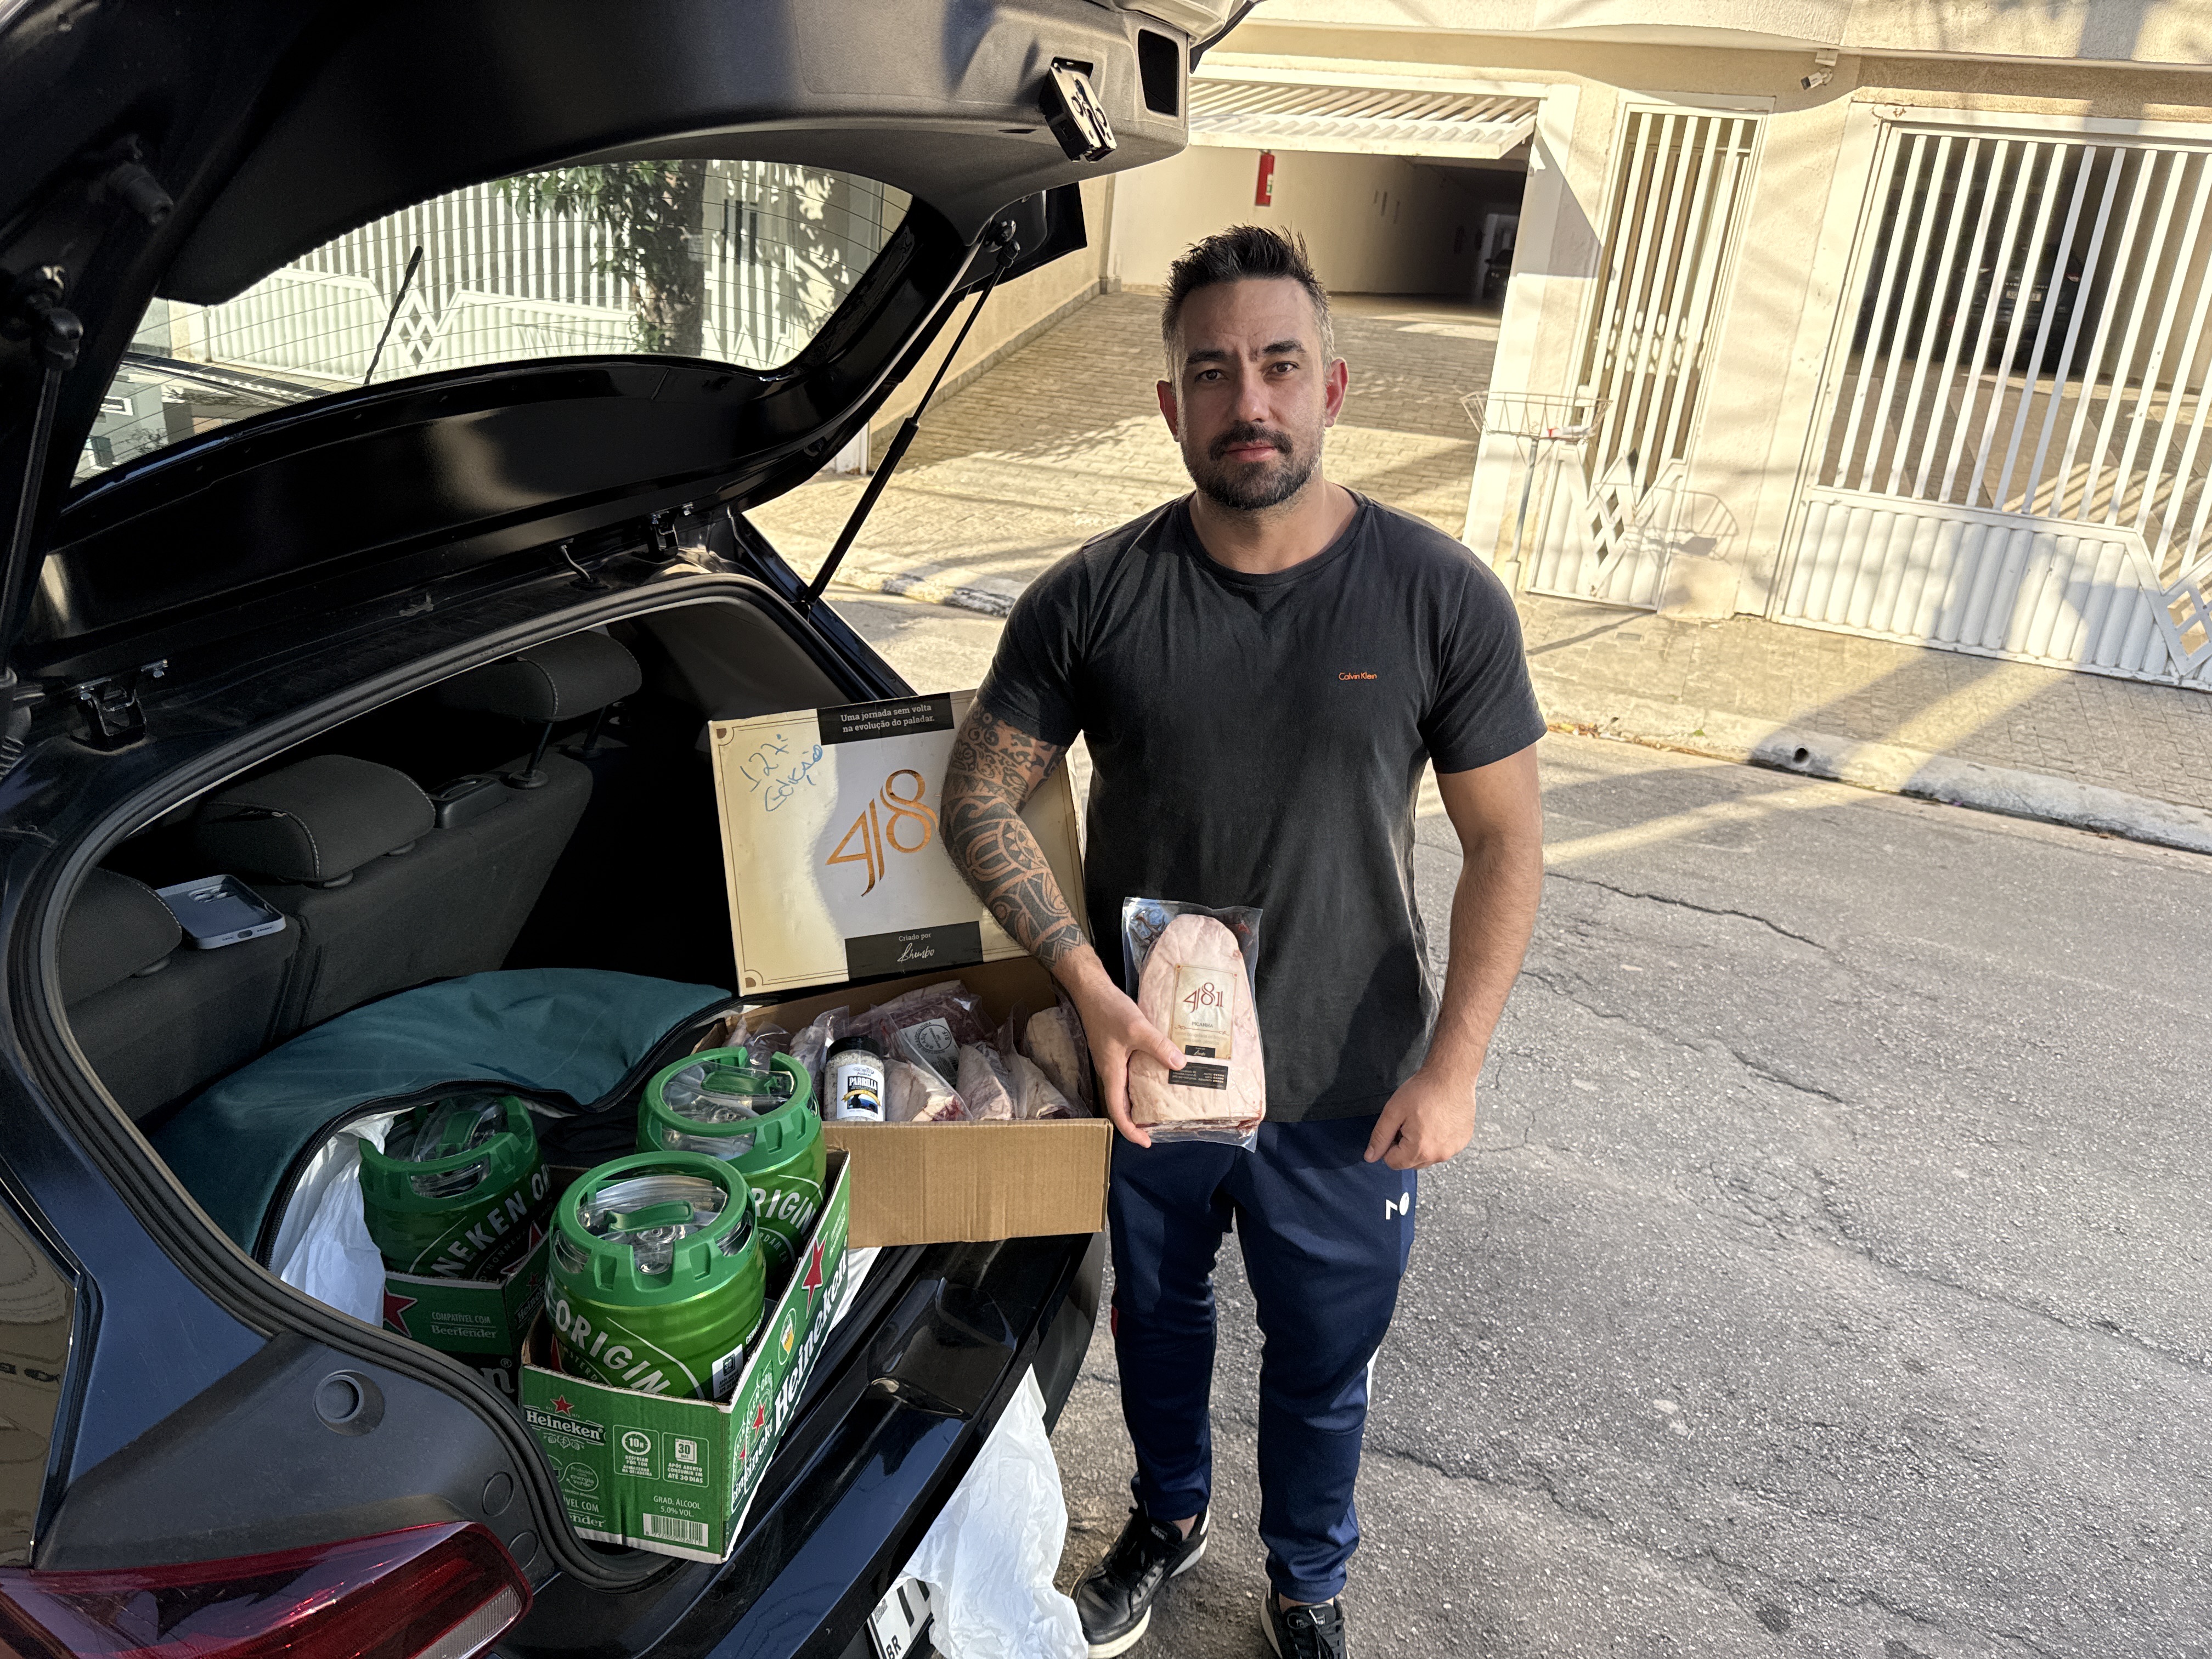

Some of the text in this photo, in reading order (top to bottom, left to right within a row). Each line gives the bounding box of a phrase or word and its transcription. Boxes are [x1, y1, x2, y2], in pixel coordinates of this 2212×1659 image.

[1339, 672, 1377, 681] Calvin Klein
[861, 709, 891, 721] jornada
[854, 720, 890, 731] evolução
[904, 715, 935, 727] paladar.
[825, 769, 939, 897] 48
[898, 934, 920, 942] Criado
[921, 1032, 934, 1049] BRASIL
[849, 1077, 877, 1091] PARRILLA
[752, 1188, 816, 1237] RIGIN
[431, 1190, 527, 1277] NEKEN
[517, 1285, 545, 1323] Heinek
[432, 1312, 491, 1324] COMPATÍVEL COM
[431, 1325, 498, 1339] BeerTender
[555, 1299, 671, 1394] ORIGIN
[774, 1249, 847, 1437] Heineken
[526, 1410, 601, 1440] Heineken
[629, 1437, 644, 1448] 10H
[678, 1443, 691, 1454] 30
[667, 1467, 694, 1476] CONSUMIR
[571, 1475, 594, 1485] energia
[582, 1501, 599, 1513] COM
[653, 1496, 701, 1510] GRAD. ÁLCOOL
[660, 1505, 695, 1517] 5,0% VOL.
[886, 1635, 901, 1659] BR
